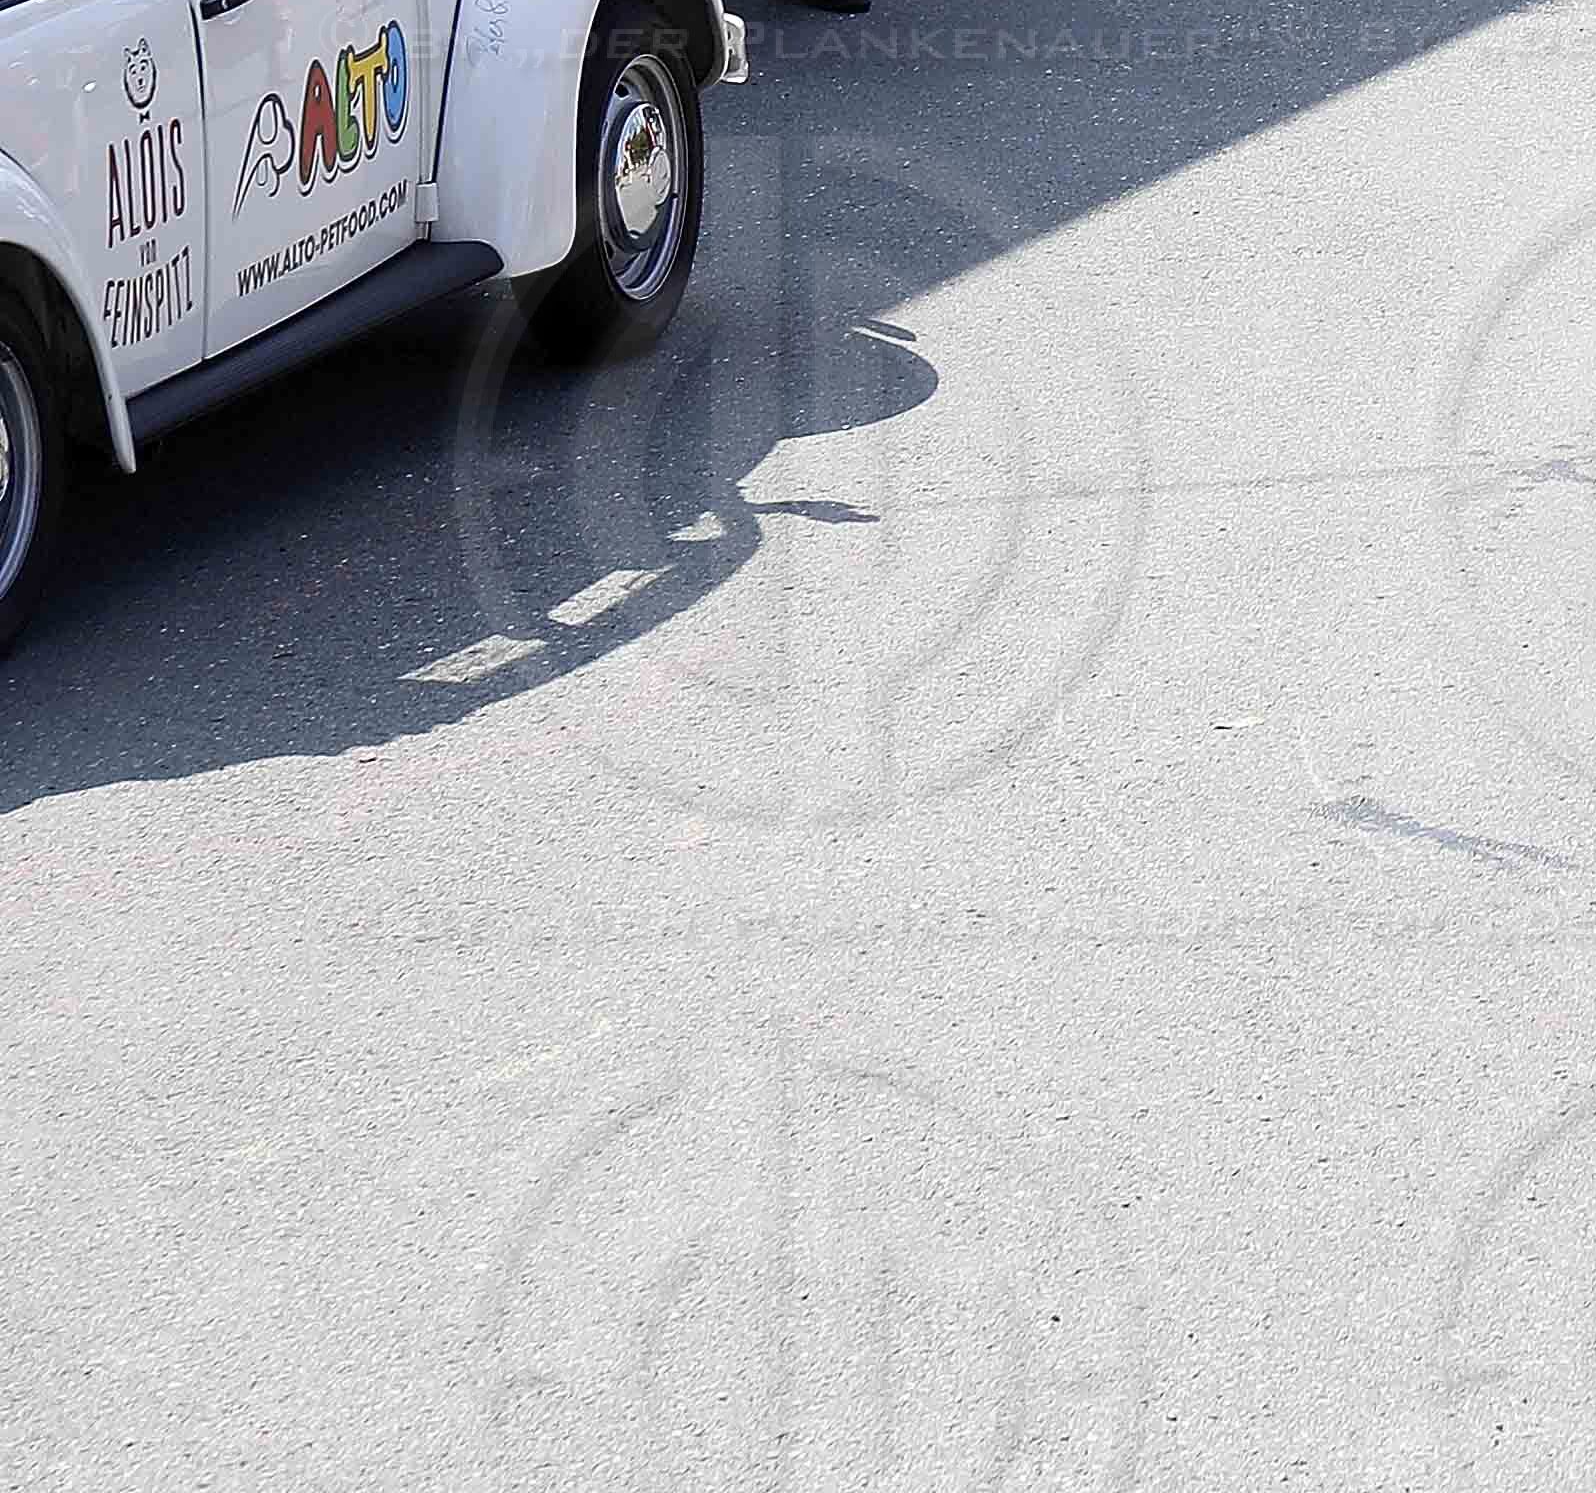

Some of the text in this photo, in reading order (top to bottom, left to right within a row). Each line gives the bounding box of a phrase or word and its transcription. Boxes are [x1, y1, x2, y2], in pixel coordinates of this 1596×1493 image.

[299, 19, 408, 193] ALTO
[108, 118, 185, 248] ALOIS
[237, 179, 408, 297] WWW.ALTO-PETFOOD.COM
